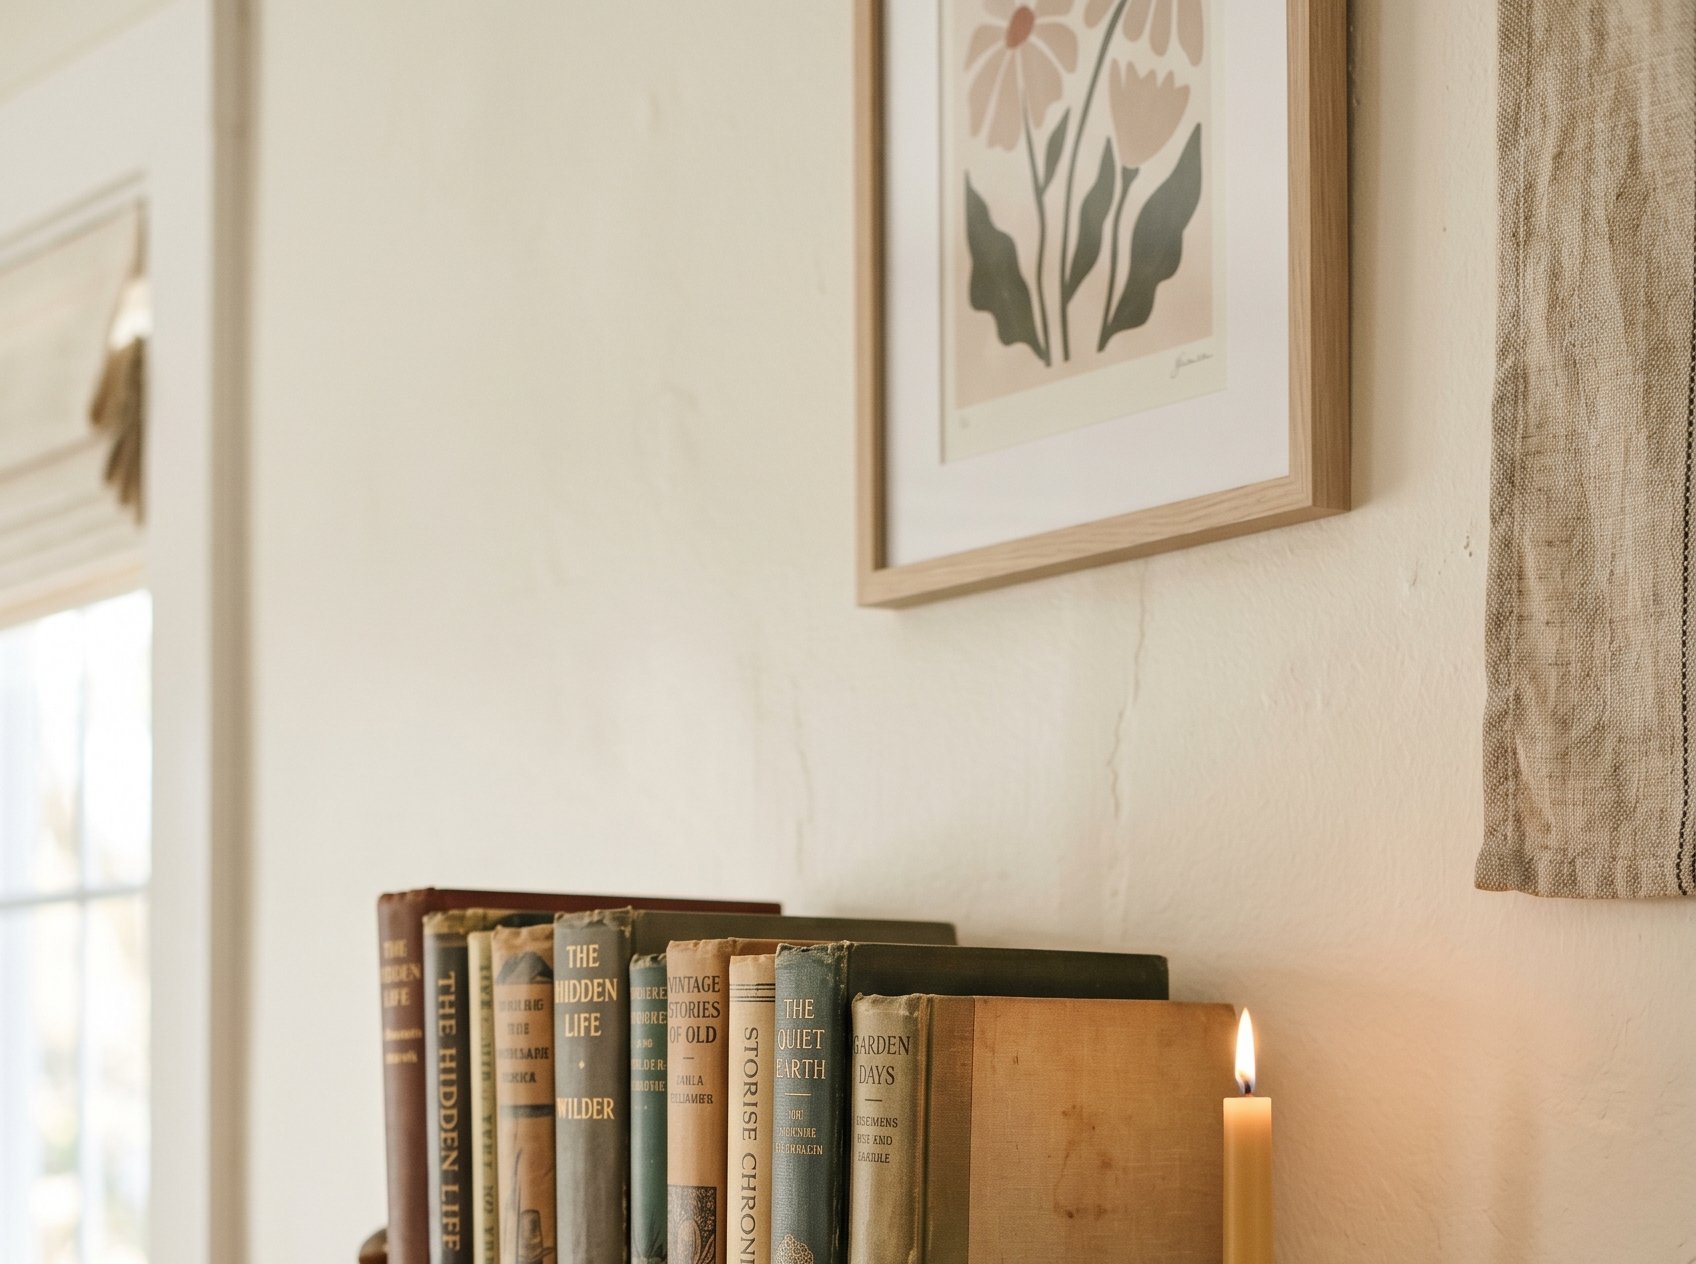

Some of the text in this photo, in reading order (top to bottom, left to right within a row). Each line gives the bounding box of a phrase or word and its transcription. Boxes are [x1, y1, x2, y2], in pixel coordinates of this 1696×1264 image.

[566, 943, 600, 969] THE
[554, 977, 618, 1004] HIDDEN
[667, 975, 721, 993] VINTAGE
[438, 970, 457, 1038] THE
[668, 1000, 721, 1019] STORIES
[784, 998, 815, 1019] THE
[565, 1012, 602, 1038] LIFE
[669, 1025, 717, 1044] OF OLD
[777, 1029, 826, 1051] QUIET
[852, 1034, 911, 1056] GARDEN
[776, 1058, 827, 1080] EARTH
[858, 1064, 895, 1086] DAYS
[742, 1027, 759, 1142] STORISE
[438, 1047, 460, 1173] HIDDEN
[556, 1096, 615, 1120] WILDER
